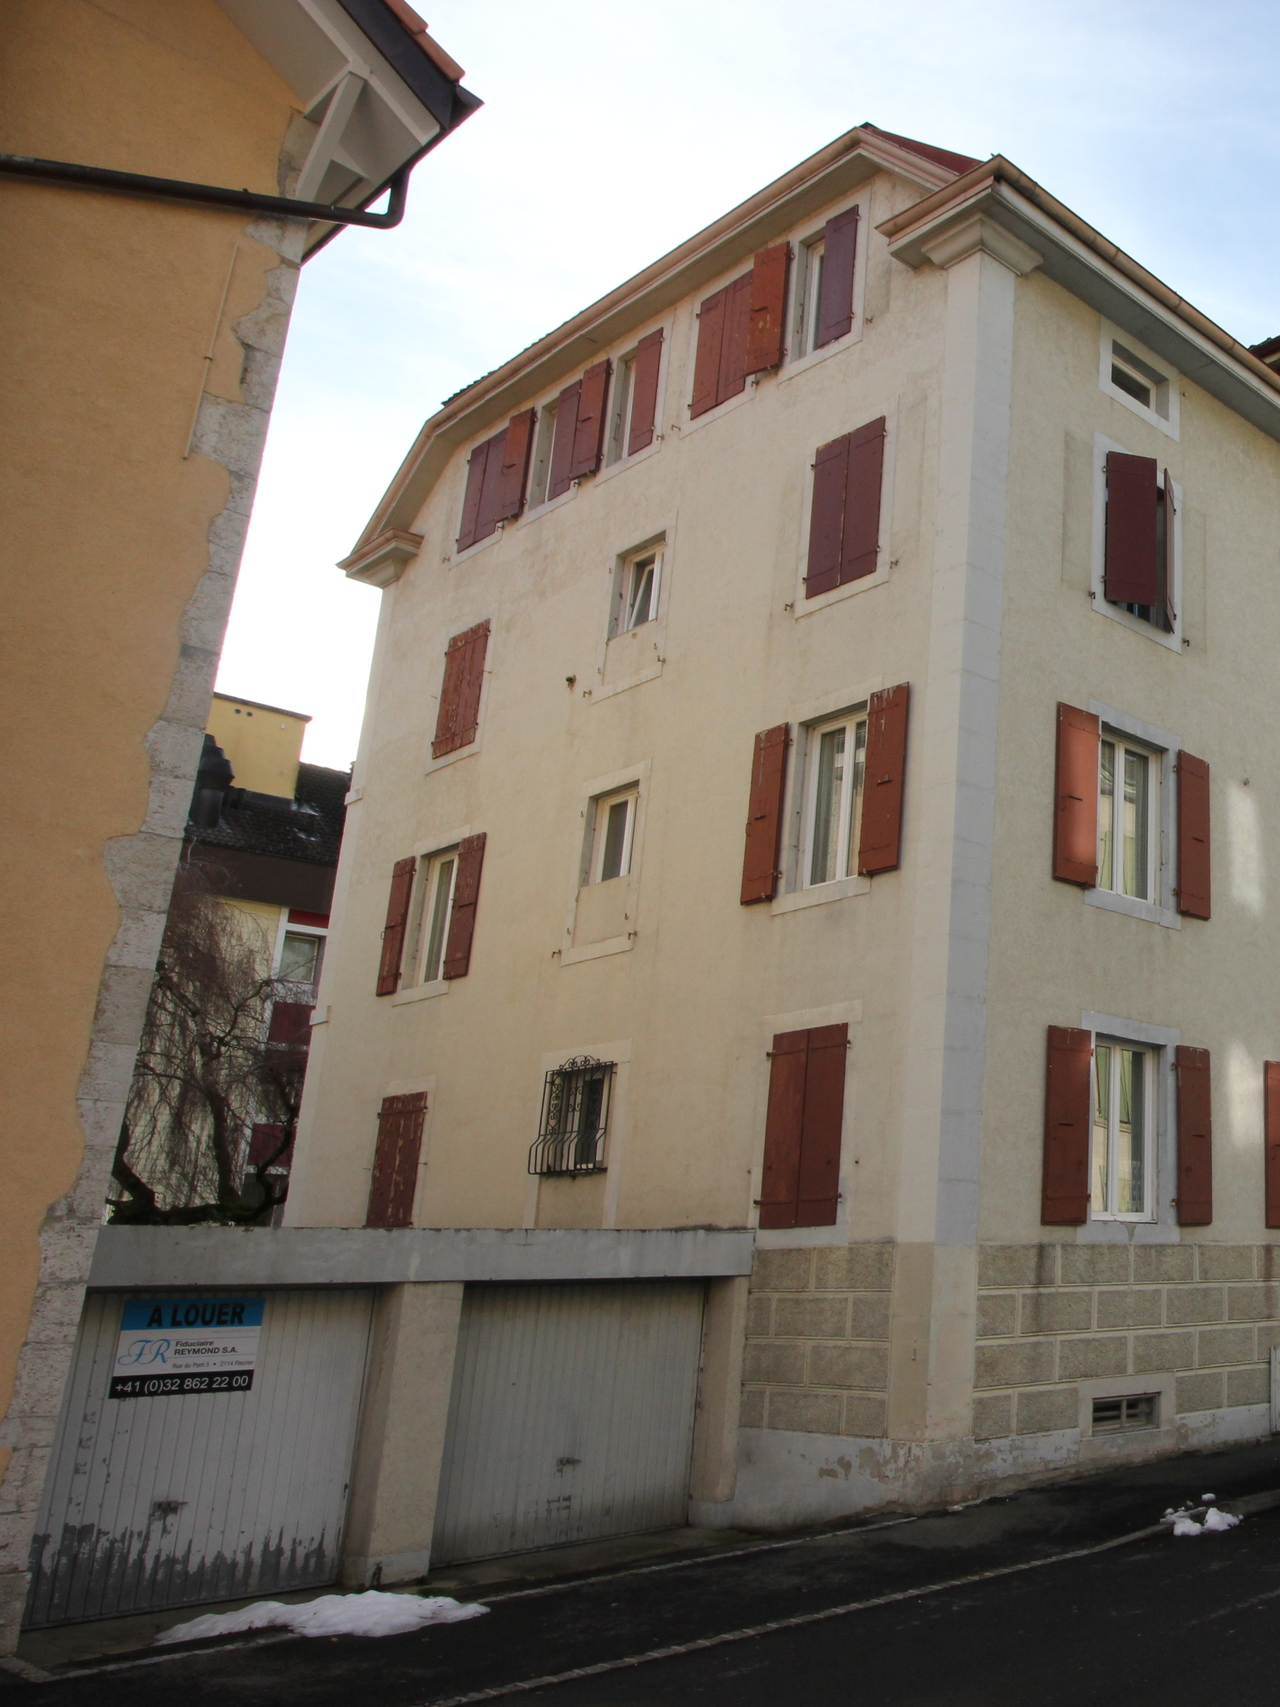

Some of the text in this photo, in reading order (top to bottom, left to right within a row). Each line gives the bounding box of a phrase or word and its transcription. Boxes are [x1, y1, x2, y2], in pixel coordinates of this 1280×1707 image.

[170, 1303, 246, 1327] LOUER
[174, 1346, 238, 1356] REYMOND S.A.
[175, 1340, 214, 1348] Fiduciaire
[115, 1375, 249, 1394] +41 (0)32 862 22 00
